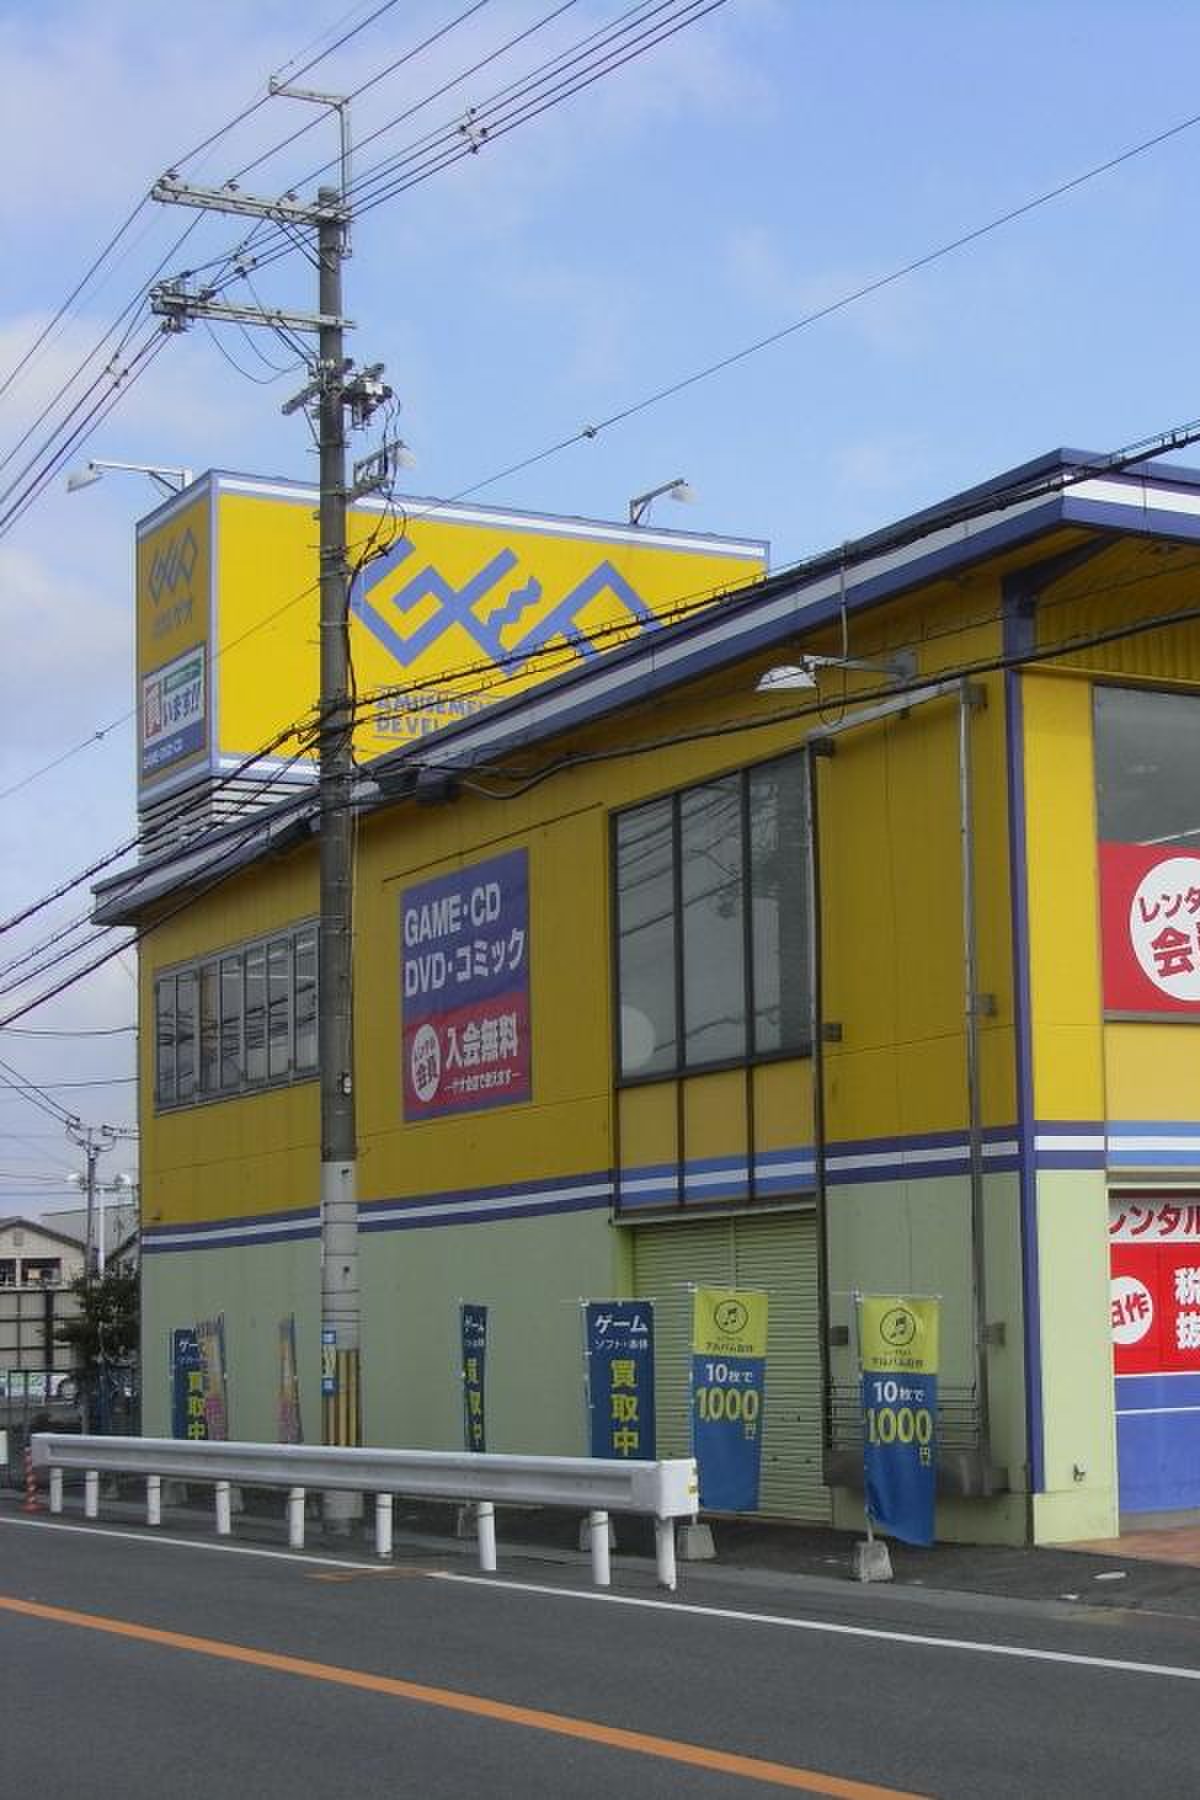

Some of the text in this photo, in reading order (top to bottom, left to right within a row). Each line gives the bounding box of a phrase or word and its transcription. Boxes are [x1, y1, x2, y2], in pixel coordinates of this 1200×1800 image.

[595, 1315, 648, 1334] ゲーム
[611, 1359, 639, 1457] 買取中
